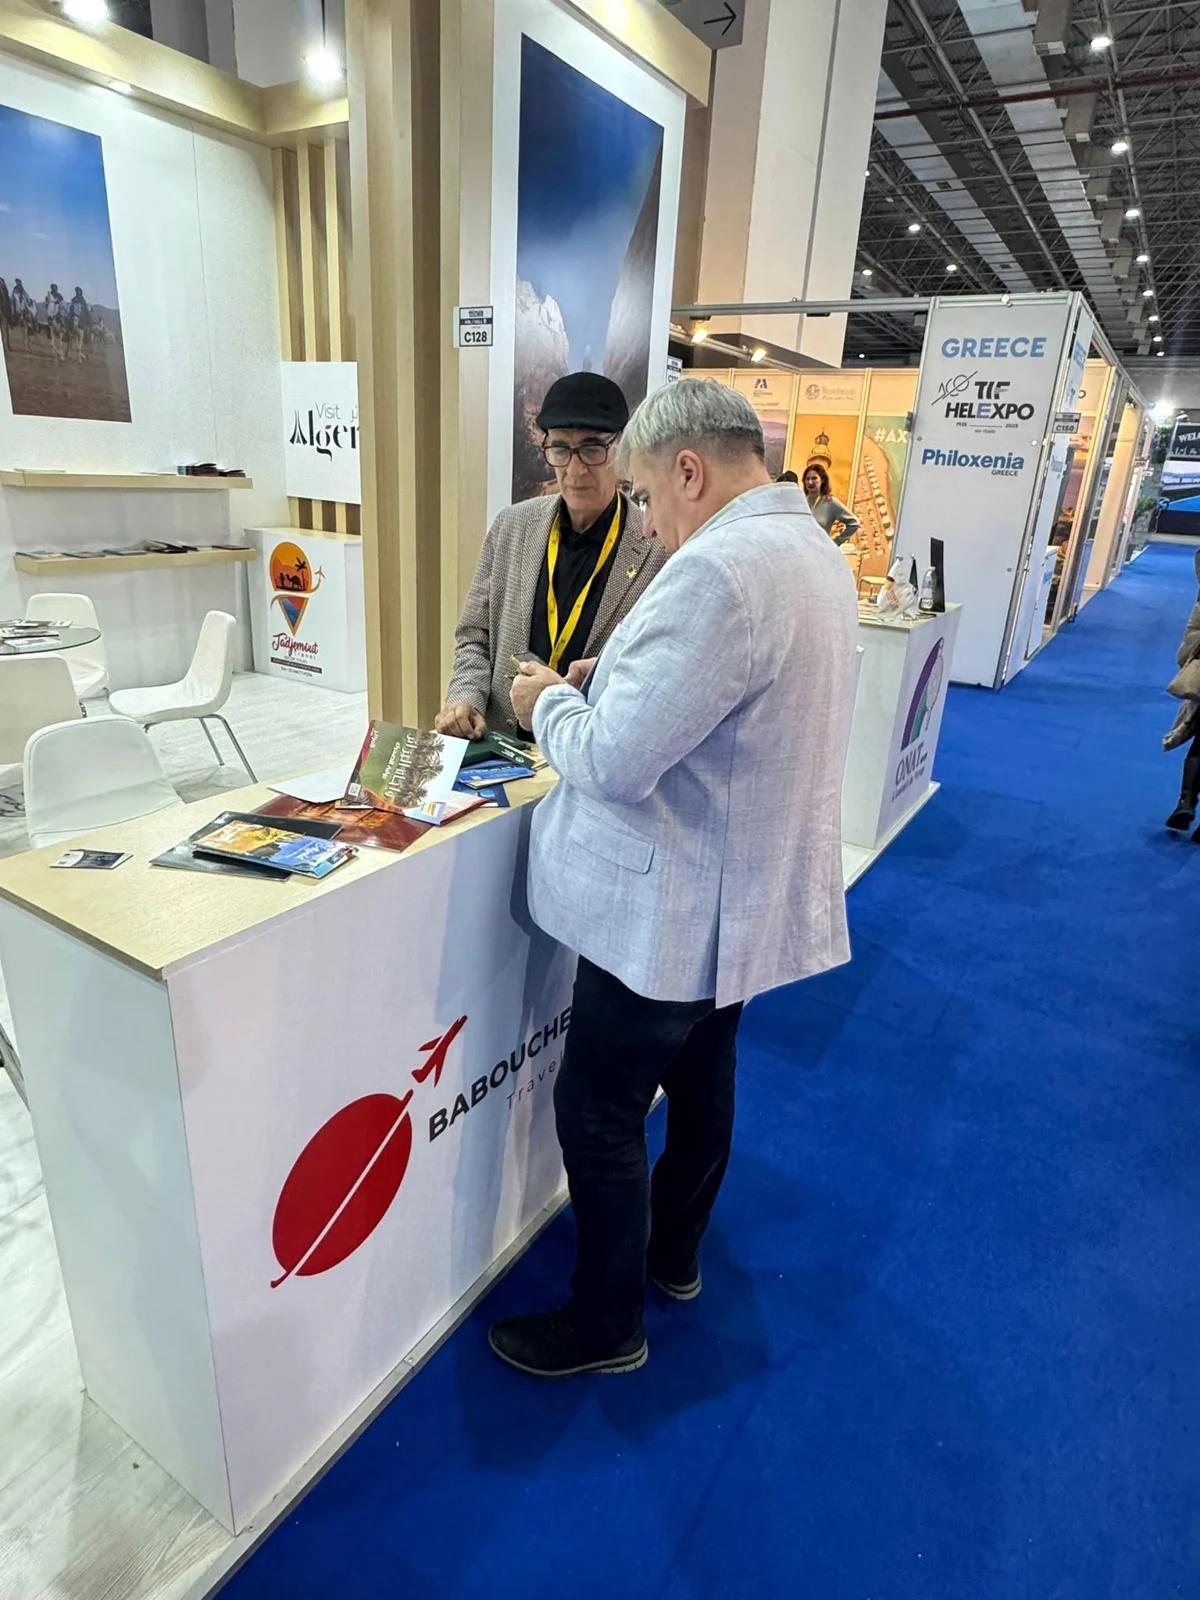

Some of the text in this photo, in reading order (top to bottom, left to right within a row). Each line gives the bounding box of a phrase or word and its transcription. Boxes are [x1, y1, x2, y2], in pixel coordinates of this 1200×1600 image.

[464, 331, 488, 343] C128
[941, 336, 1047, 358] GREECE
[974, 381, 1011, 400] TIF
[315, 401, 342, 420] Visit
[945, 402, 1035, 421] HELEXPO
[921, 448, 1025, 470] Philoxenia
[991, 469, 1019, 477] GREECE
[429, 1005, 572, 1143] BABOUCHE
